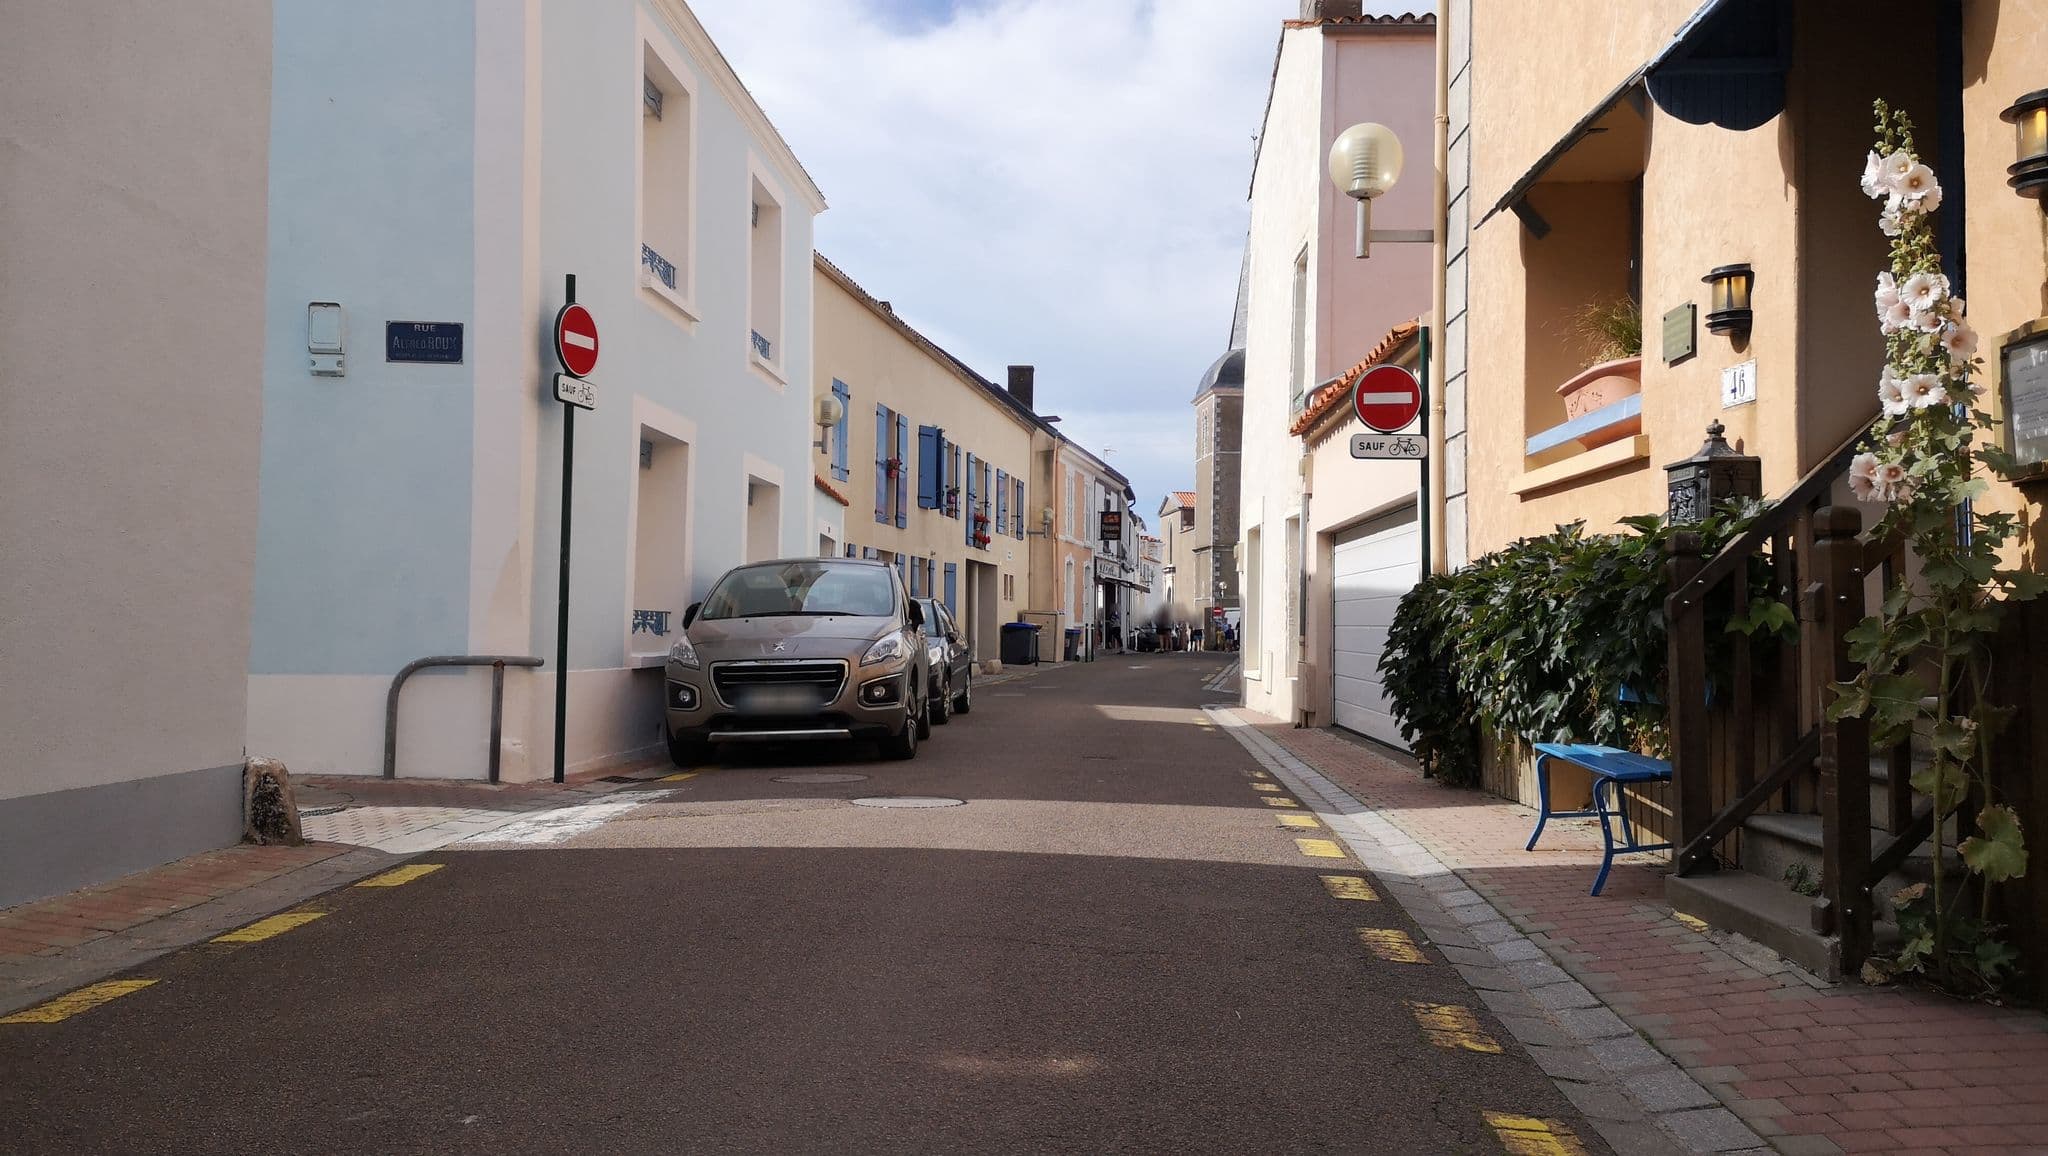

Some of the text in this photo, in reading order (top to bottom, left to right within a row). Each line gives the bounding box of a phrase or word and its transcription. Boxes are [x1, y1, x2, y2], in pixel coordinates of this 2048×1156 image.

[414, 323, 437, 332] RUE
[428, 336, 457, 350] ROUX
[561, 382, 577, 396] SAUF
[1730, 368, 1746, 400] 46
[1358, 441, 1385, 451] SAUF
